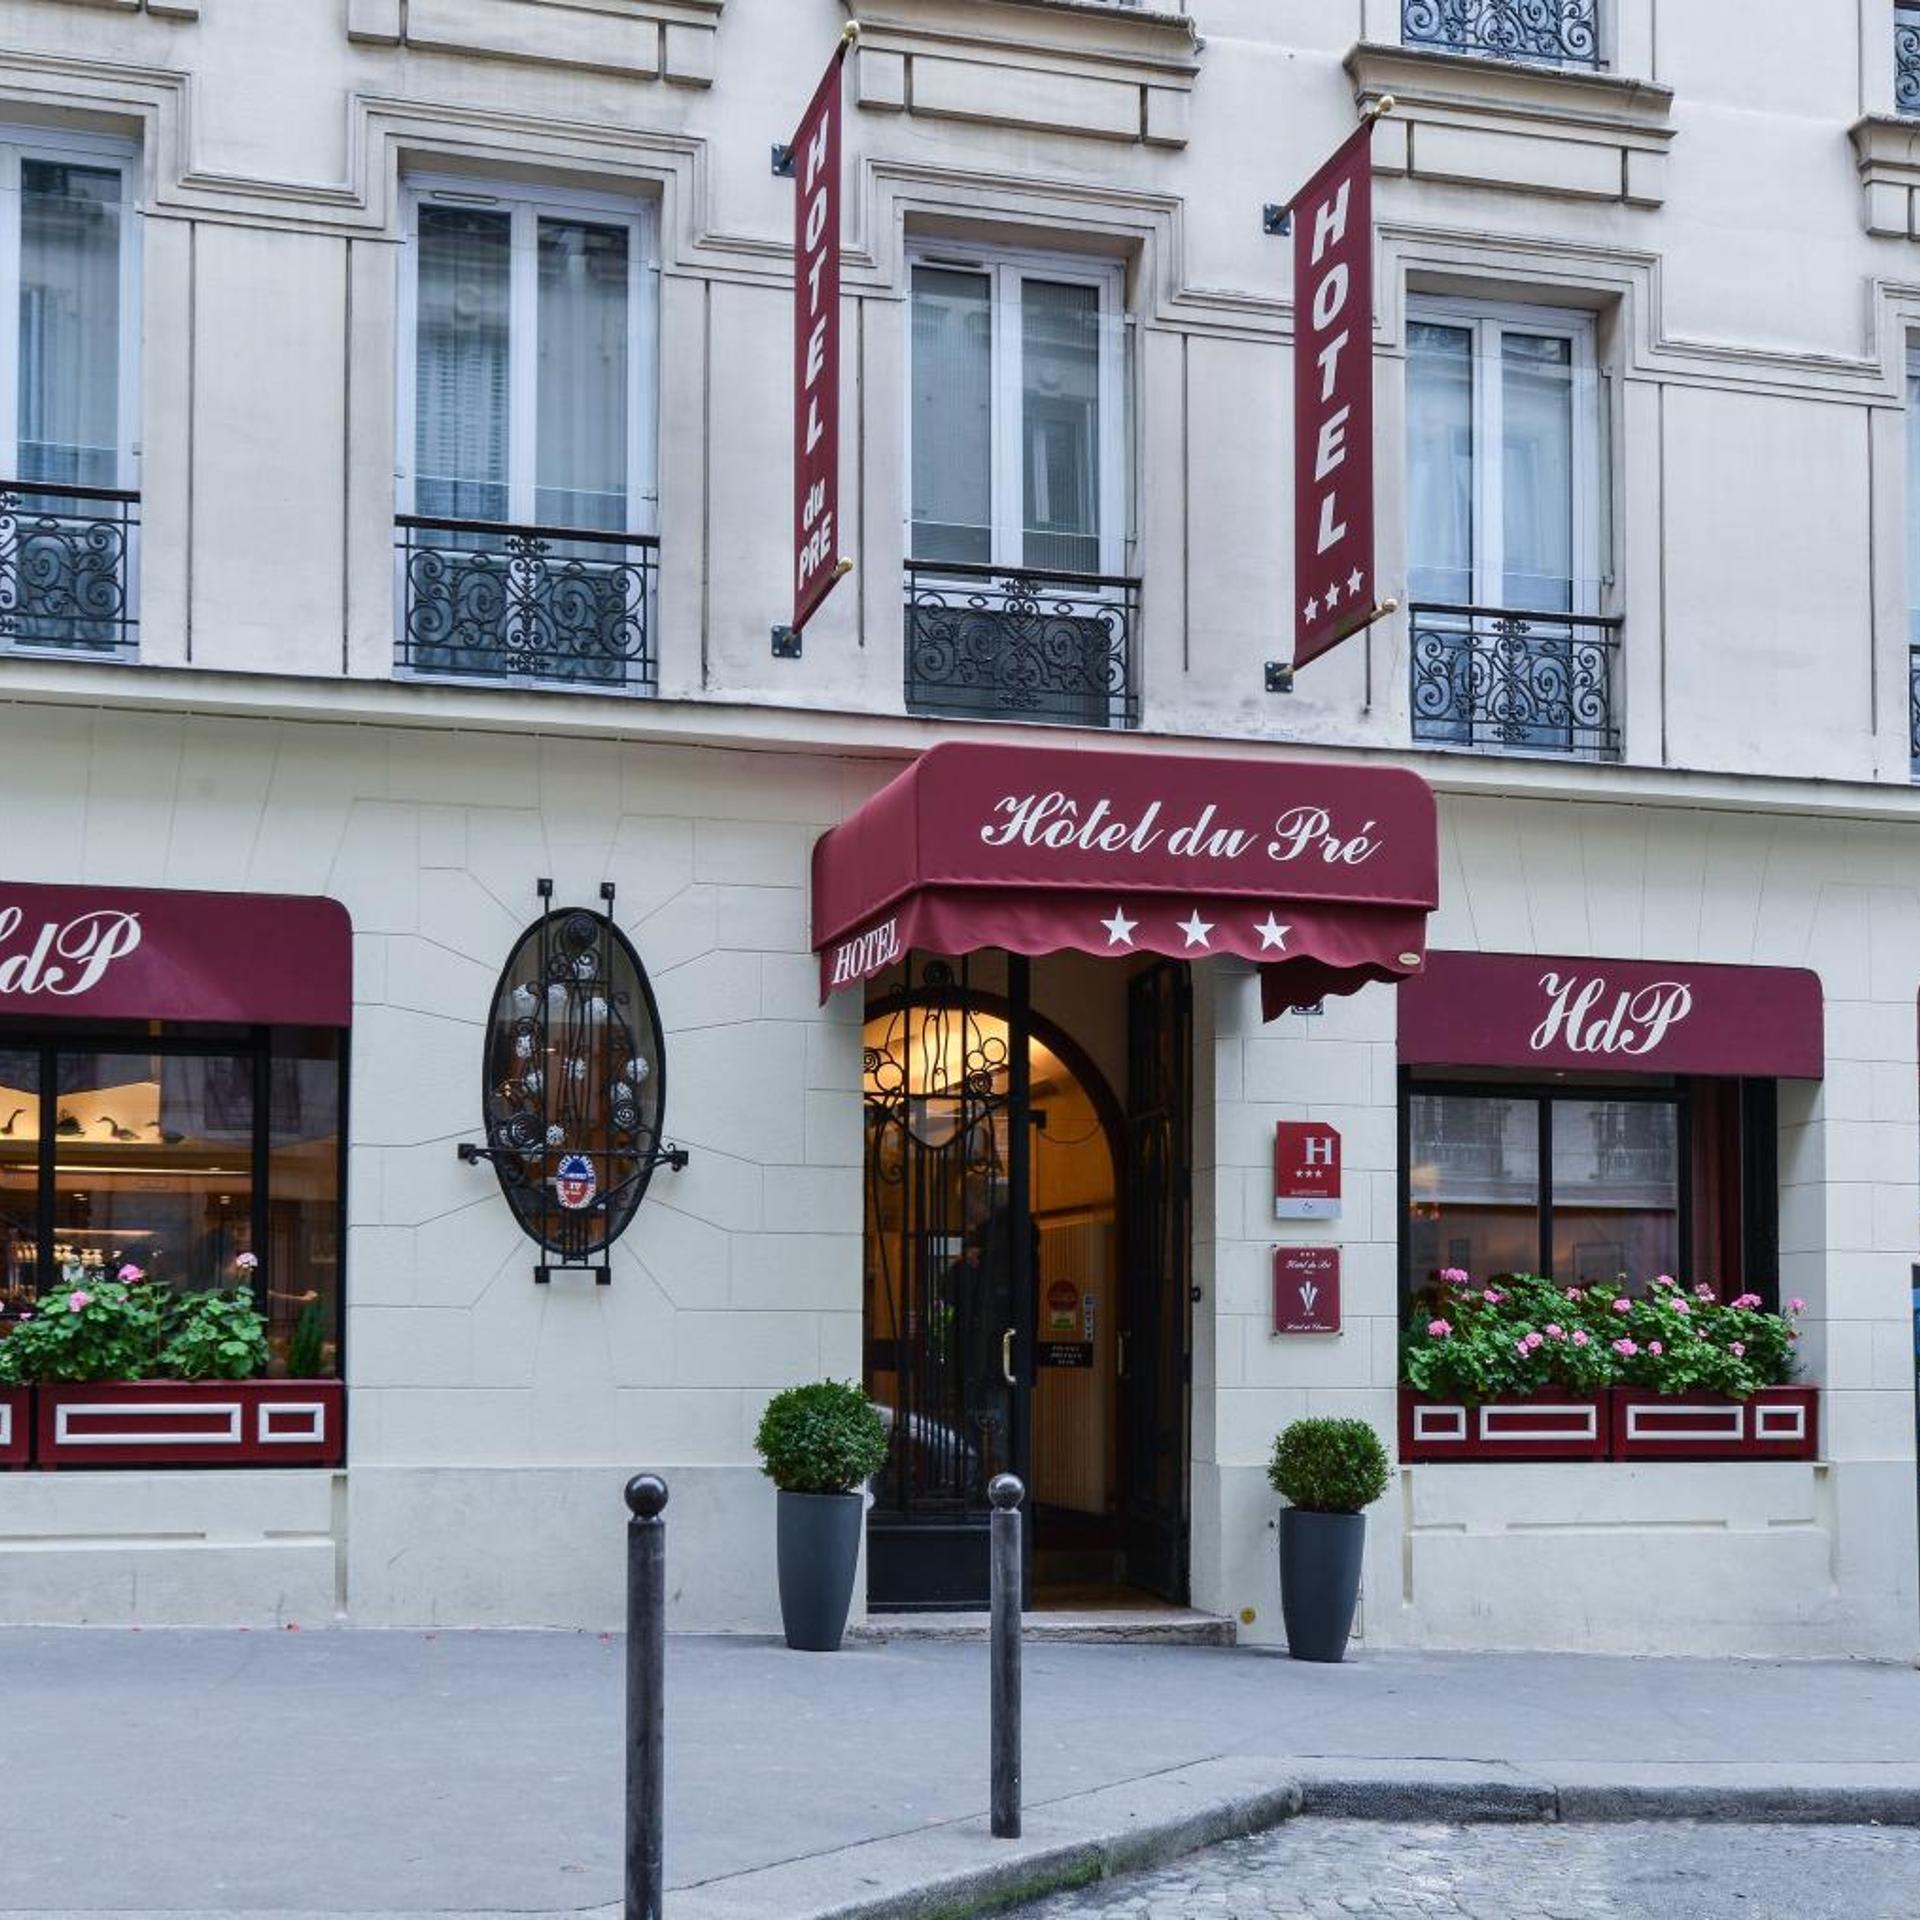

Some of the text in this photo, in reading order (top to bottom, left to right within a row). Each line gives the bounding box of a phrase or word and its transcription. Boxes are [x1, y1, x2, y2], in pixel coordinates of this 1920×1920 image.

[805, 108, 830, 455] HOTEL
[1310, 177, 1351, 554] HOTEL
[803, 477, 825, 532] du
[798, 511, 832, 591] PRE
[980, 790, 1383, 864] Hôtel du Pré
[0, 906, 141, 995] dP
[831, 918, 901, 985] HOTEL
[1529, 971, 1693, 1055] HdP
[1303, 1136, 1334, 1165] H
